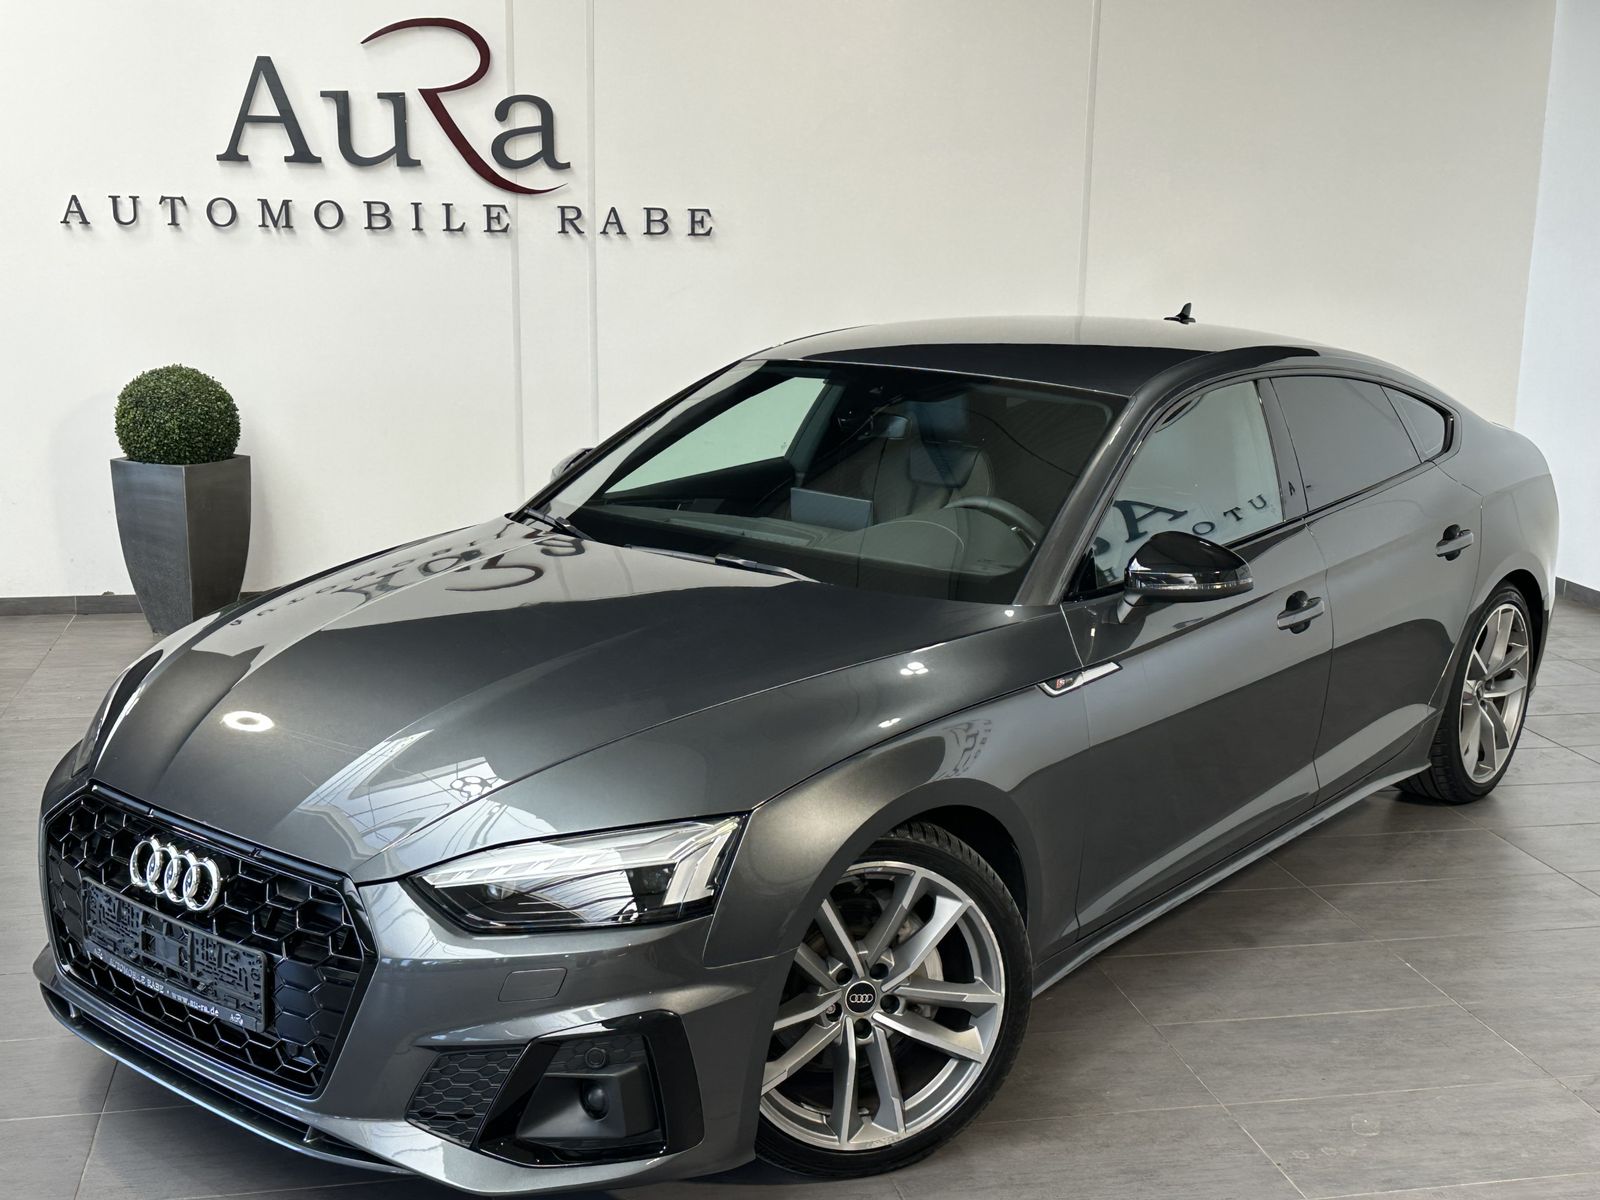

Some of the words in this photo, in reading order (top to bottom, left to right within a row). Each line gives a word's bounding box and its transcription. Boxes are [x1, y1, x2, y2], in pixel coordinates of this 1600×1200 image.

[216, 16, 571, 196] AuRa
[60, 193, 511, 235] AUTOMOBILE
[557, 205, 714, 238] RABE
